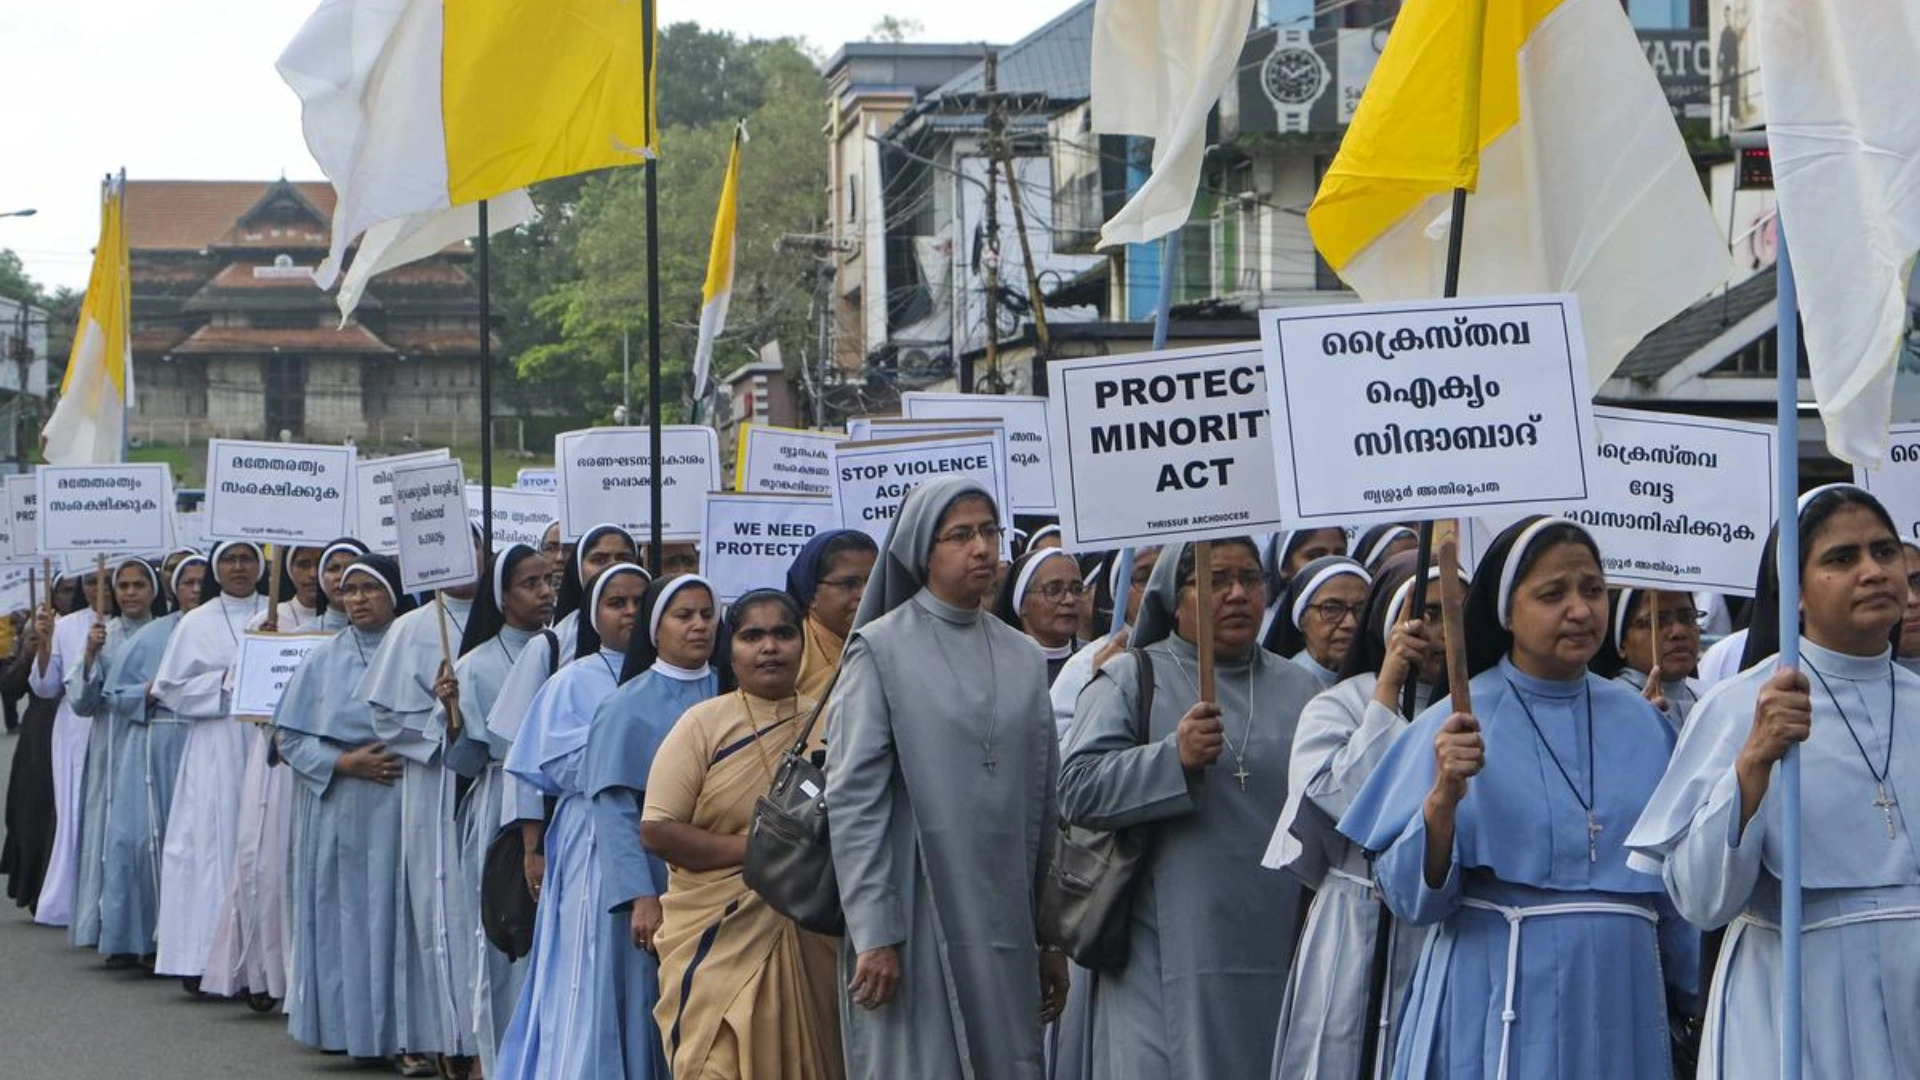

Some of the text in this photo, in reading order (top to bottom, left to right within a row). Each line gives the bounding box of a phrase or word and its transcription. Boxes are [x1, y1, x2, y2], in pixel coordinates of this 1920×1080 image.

[1322, 317, 1531, 360] ക്രൈസ്തവ
[1366, 374, 1500, 409] ഐക്യം
[1091, 409, 1270, 454] MINORIT
[1354, 414, 1542, 457] സിന്ദാബാദ്
[577, 454, 705, 468] ഭരണഘടനാകാശം
[841, 456, 988, 481] STOP VIOLENCE
[1156, 458, 1234, 492] ACT
[221, 481, 340, 502] സംരക്ഷിക്കുക
[875, 482, 919, 499] AGA
[1417, 482, 1500, 497] അതിരൂപത
[1629, 480, 1674, 504] വേട്ട
[16, 509, 37, 521] PRO
[1147, 511, 1250, 529] THRISSUR ARCHDIOCESE
[734, 522, 816, 537] WE NEED
[716, 541, 805, 556] PROTECT
